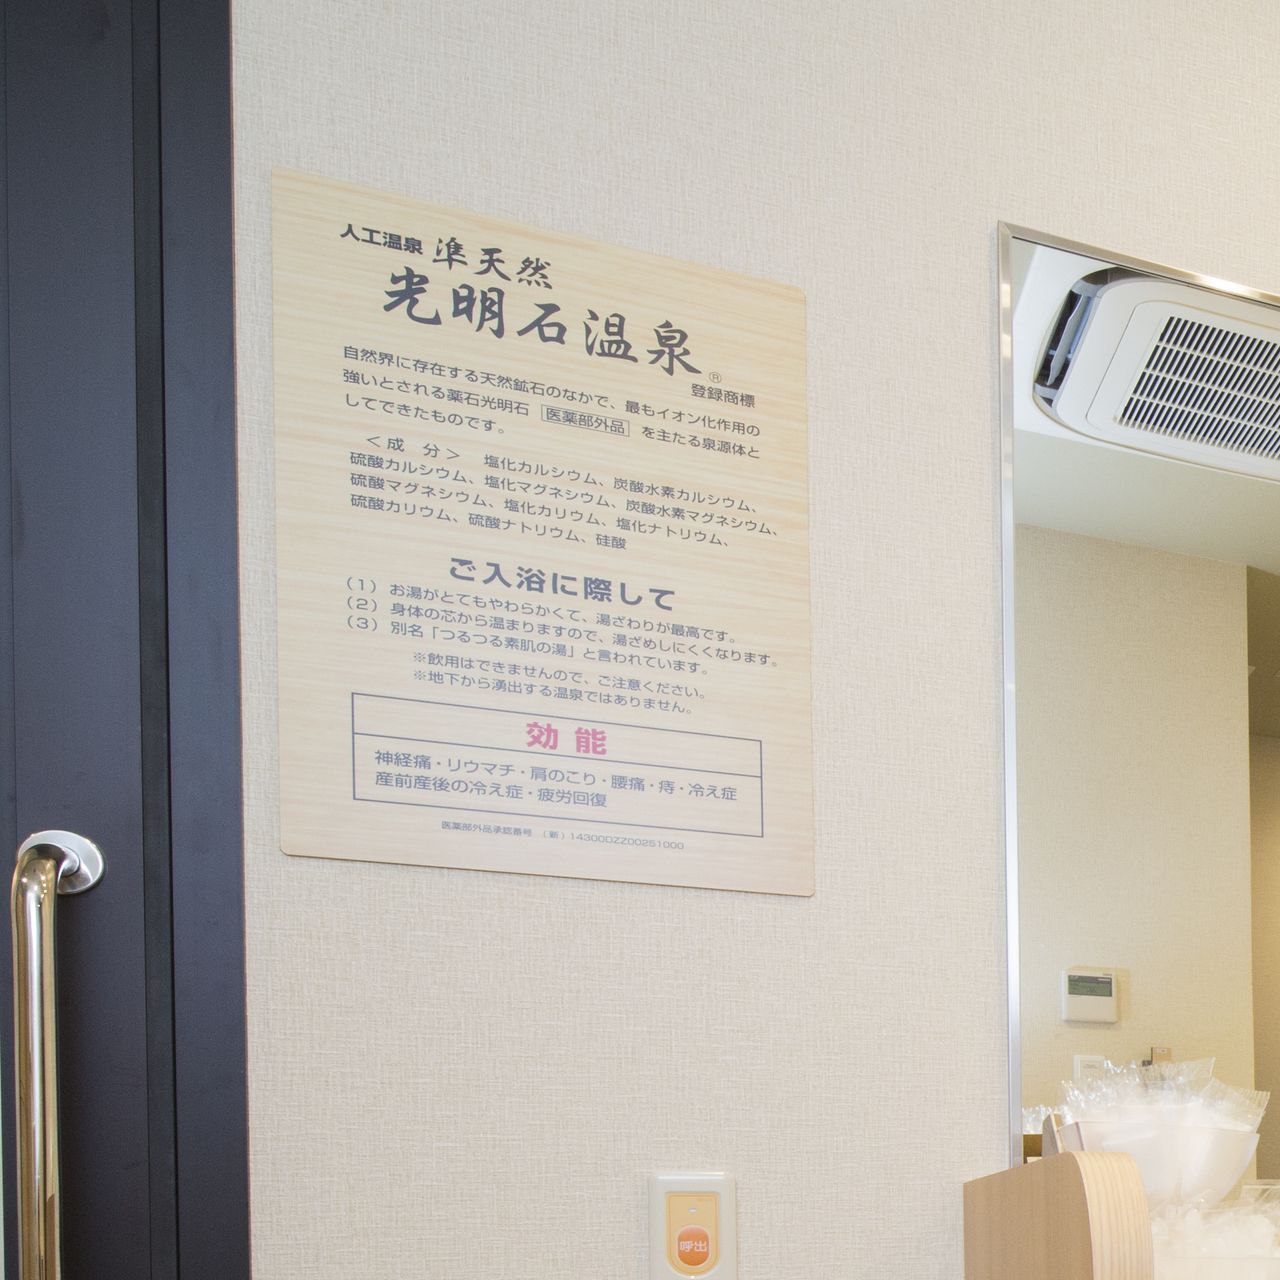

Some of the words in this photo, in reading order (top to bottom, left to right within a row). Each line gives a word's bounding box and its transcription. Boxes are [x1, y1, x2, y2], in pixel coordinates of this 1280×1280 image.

[340, 224, 423, 255] 人工温泉
[383, 265, 702, 376] 光明石温泉
[343, 368, 529, 416] 強いとされる薬石光明石
[546, 407, 625, 434] 医薬部外品
[641, 426, 760, 459] を主たる泉源体と
[346, 393, 504, 434] してできたものです。
[691, 383, 756, 408] 登録商標
[350, 451, 777, 536] 硫酸カルシウム、塩化マグネシウム、炭酸水素マグネシウム、
[350, 472, 728, 547] 硫酸マグネシウム、塩化カリウム、塩化ナトリウム、
[484, 454, 757, 513] 塩化カルシウム、炭酸水素カルシウム、
[449, 557, 675, 611] ご入浴に際して
[679, 1240, 707, 1253] 呼出
